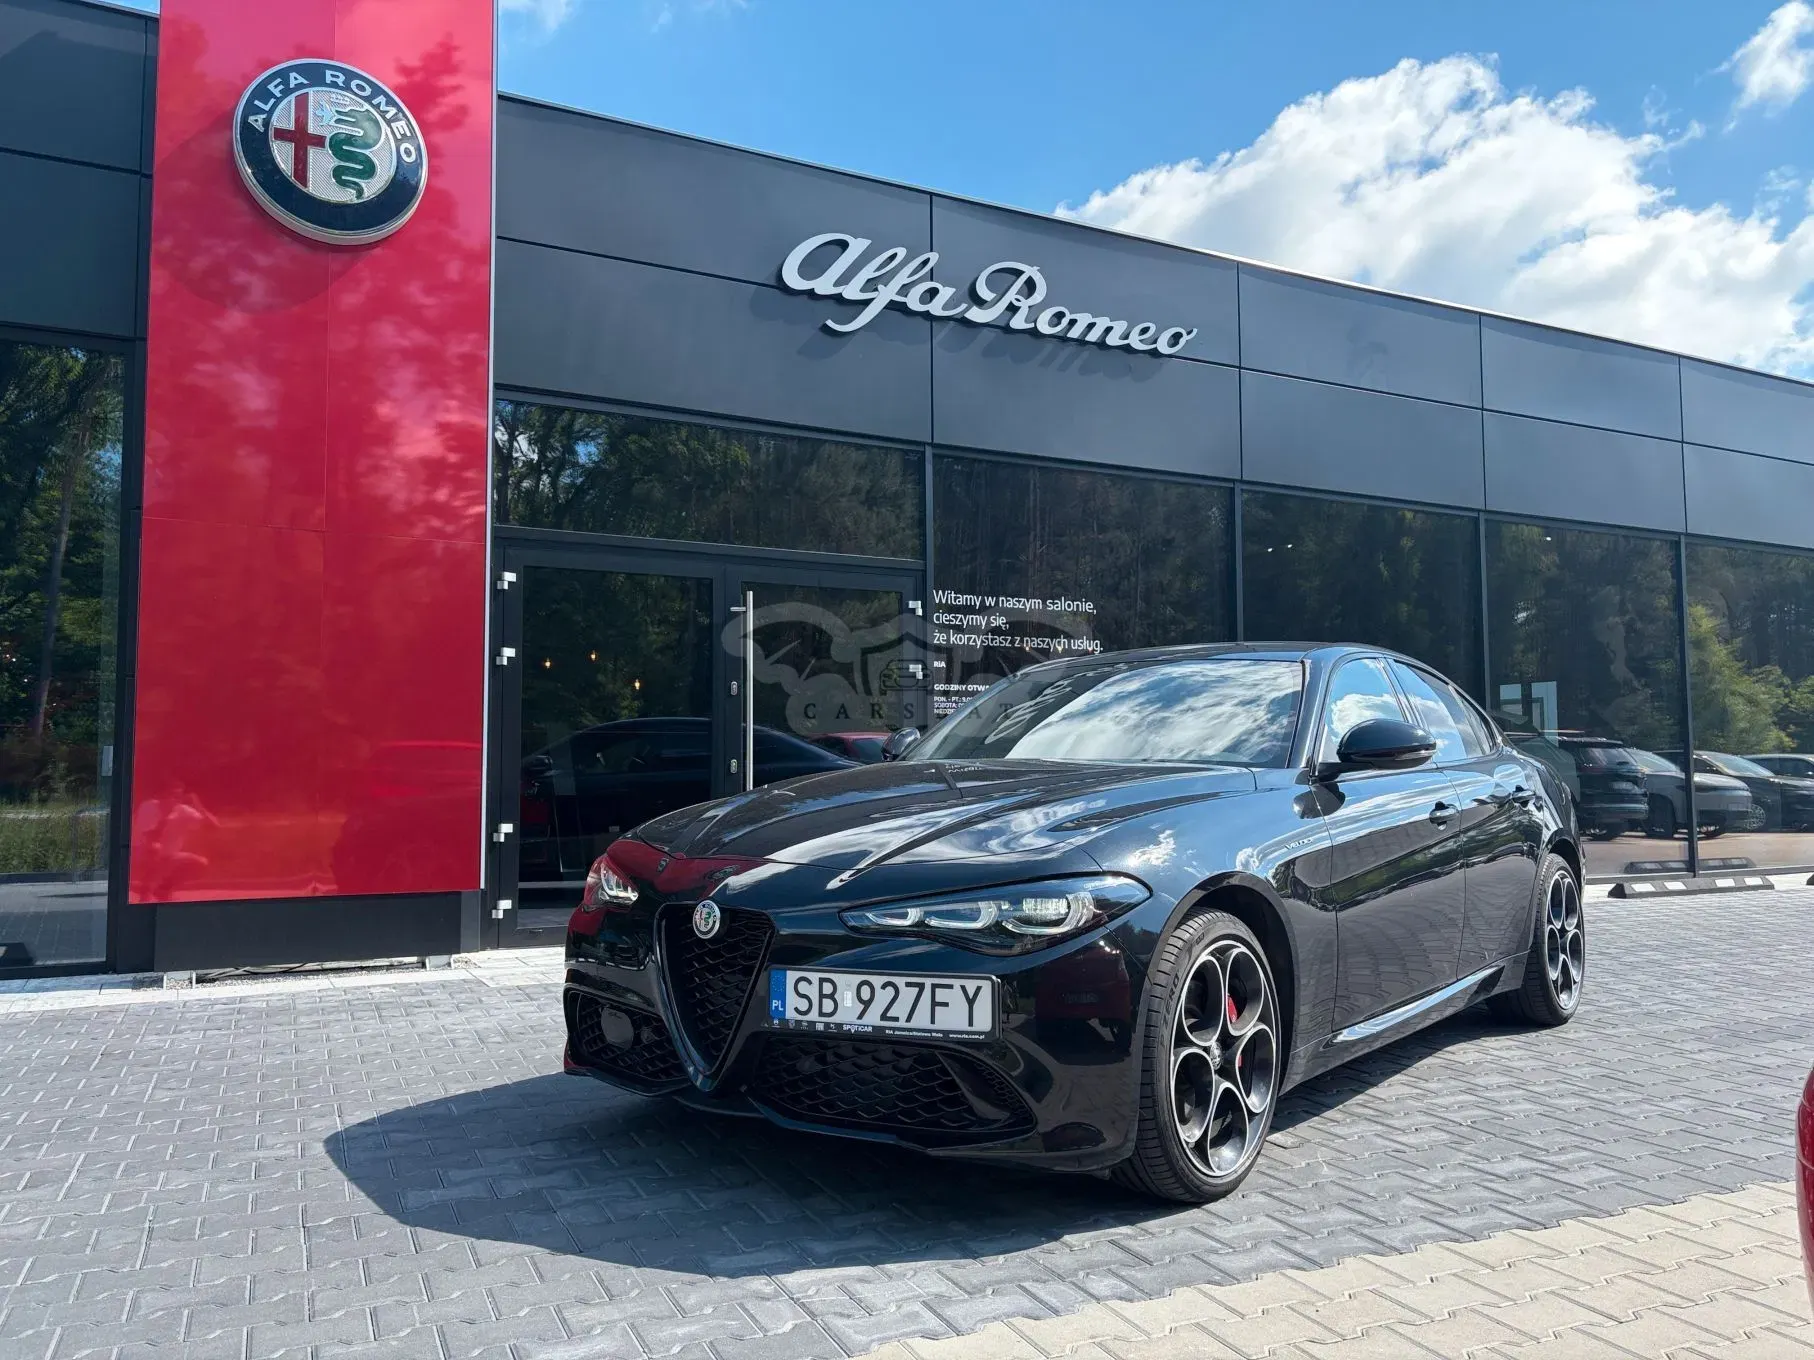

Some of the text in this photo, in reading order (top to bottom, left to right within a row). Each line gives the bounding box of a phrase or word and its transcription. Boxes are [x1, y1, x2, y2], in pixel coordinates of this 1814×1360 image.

[248, 70, 416, 163] ALFA ROMEO
[963, 261, 1198, 355] Romeo
[933, 589, 1097, 615] Witamy w naszym salonie,
[933, 610, 1009, 630] cieszymy się,
[933, 630, 1103, 654] że korzystasz z naszych usług.
[772, 1000, 784, 1011] PL
[793, 976, 984, 1028] SB 927FY
